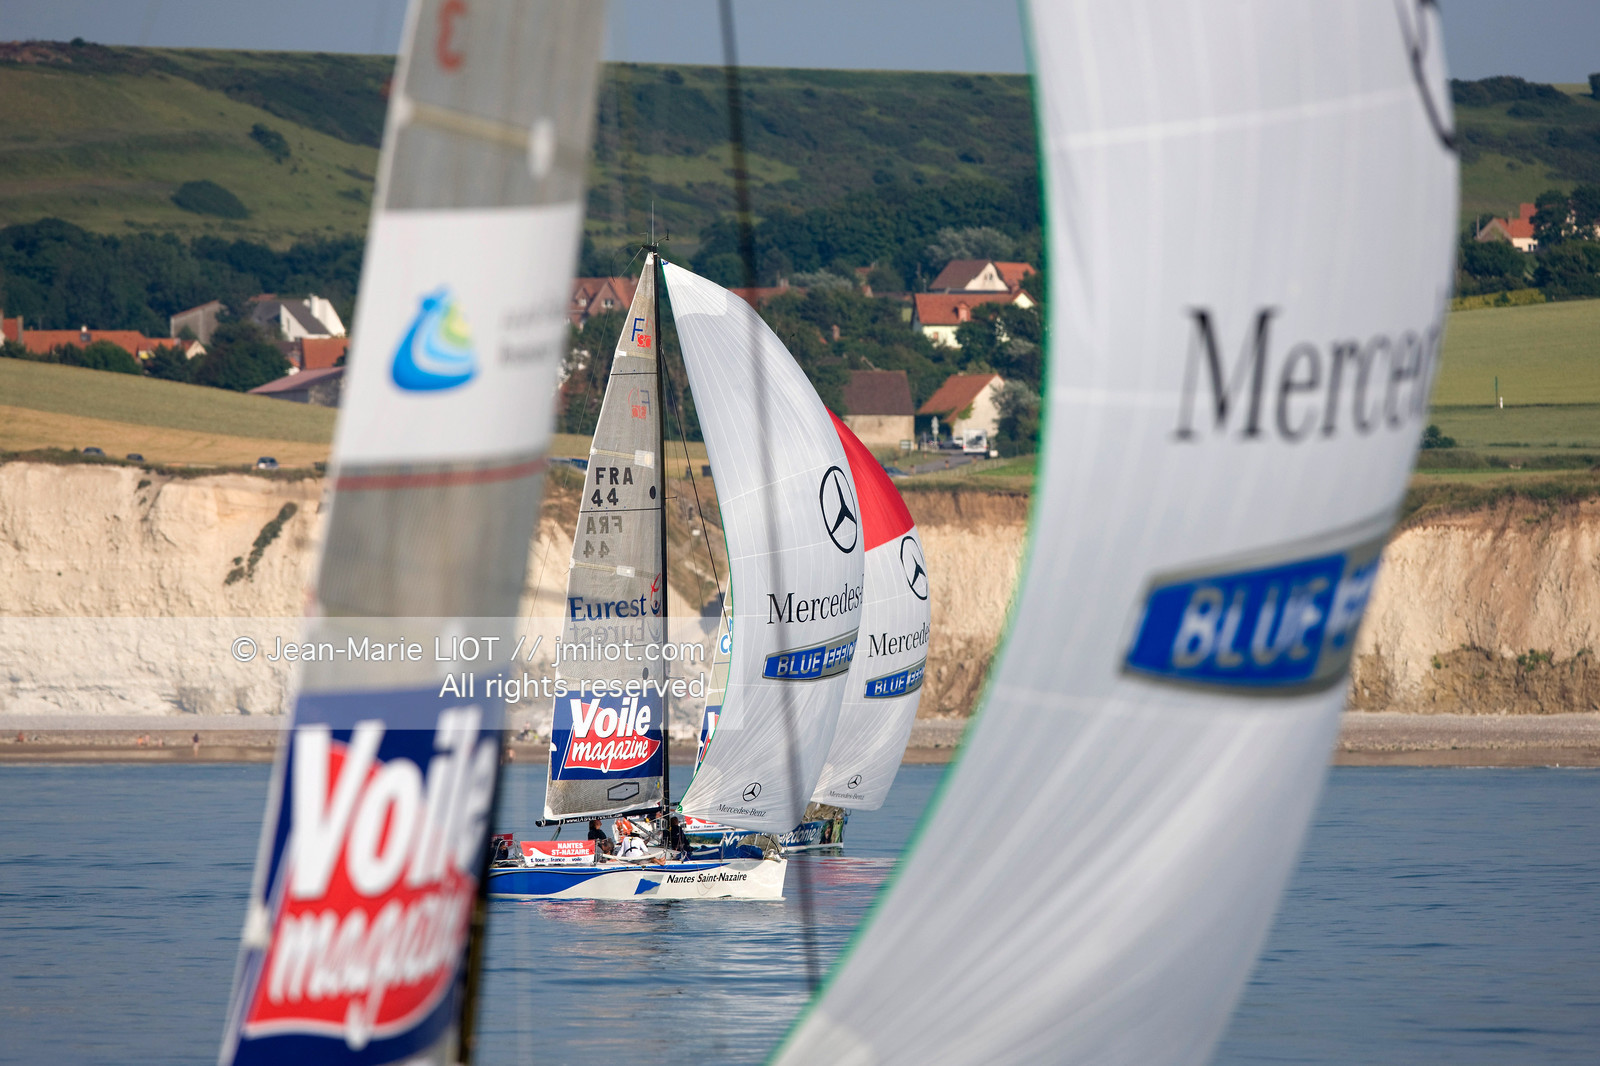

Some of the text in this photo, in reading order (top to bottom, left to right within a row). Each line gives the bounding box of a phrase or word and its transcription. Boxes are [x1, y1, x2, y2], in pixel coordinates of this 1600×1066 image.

[595, 467, 634, 486] FRA
[591, 487, 619, 507] 44
[568, 593, 647, 622] Eurest
[1171, 577, 1329, 671] BLUE
[777, 651, 822, 676] BLUE
[874, 673, 906, 696] BLUE
[570, 697, 650, 739] Voile
[571, 738, 649, 773] magazine
[716, 803, 767, 818] Mercedes-Benz
[551, 848, 589, 856] ST-NAZAIRE
[666, 872, 748, 884] Nantes Saint-Nazaire
